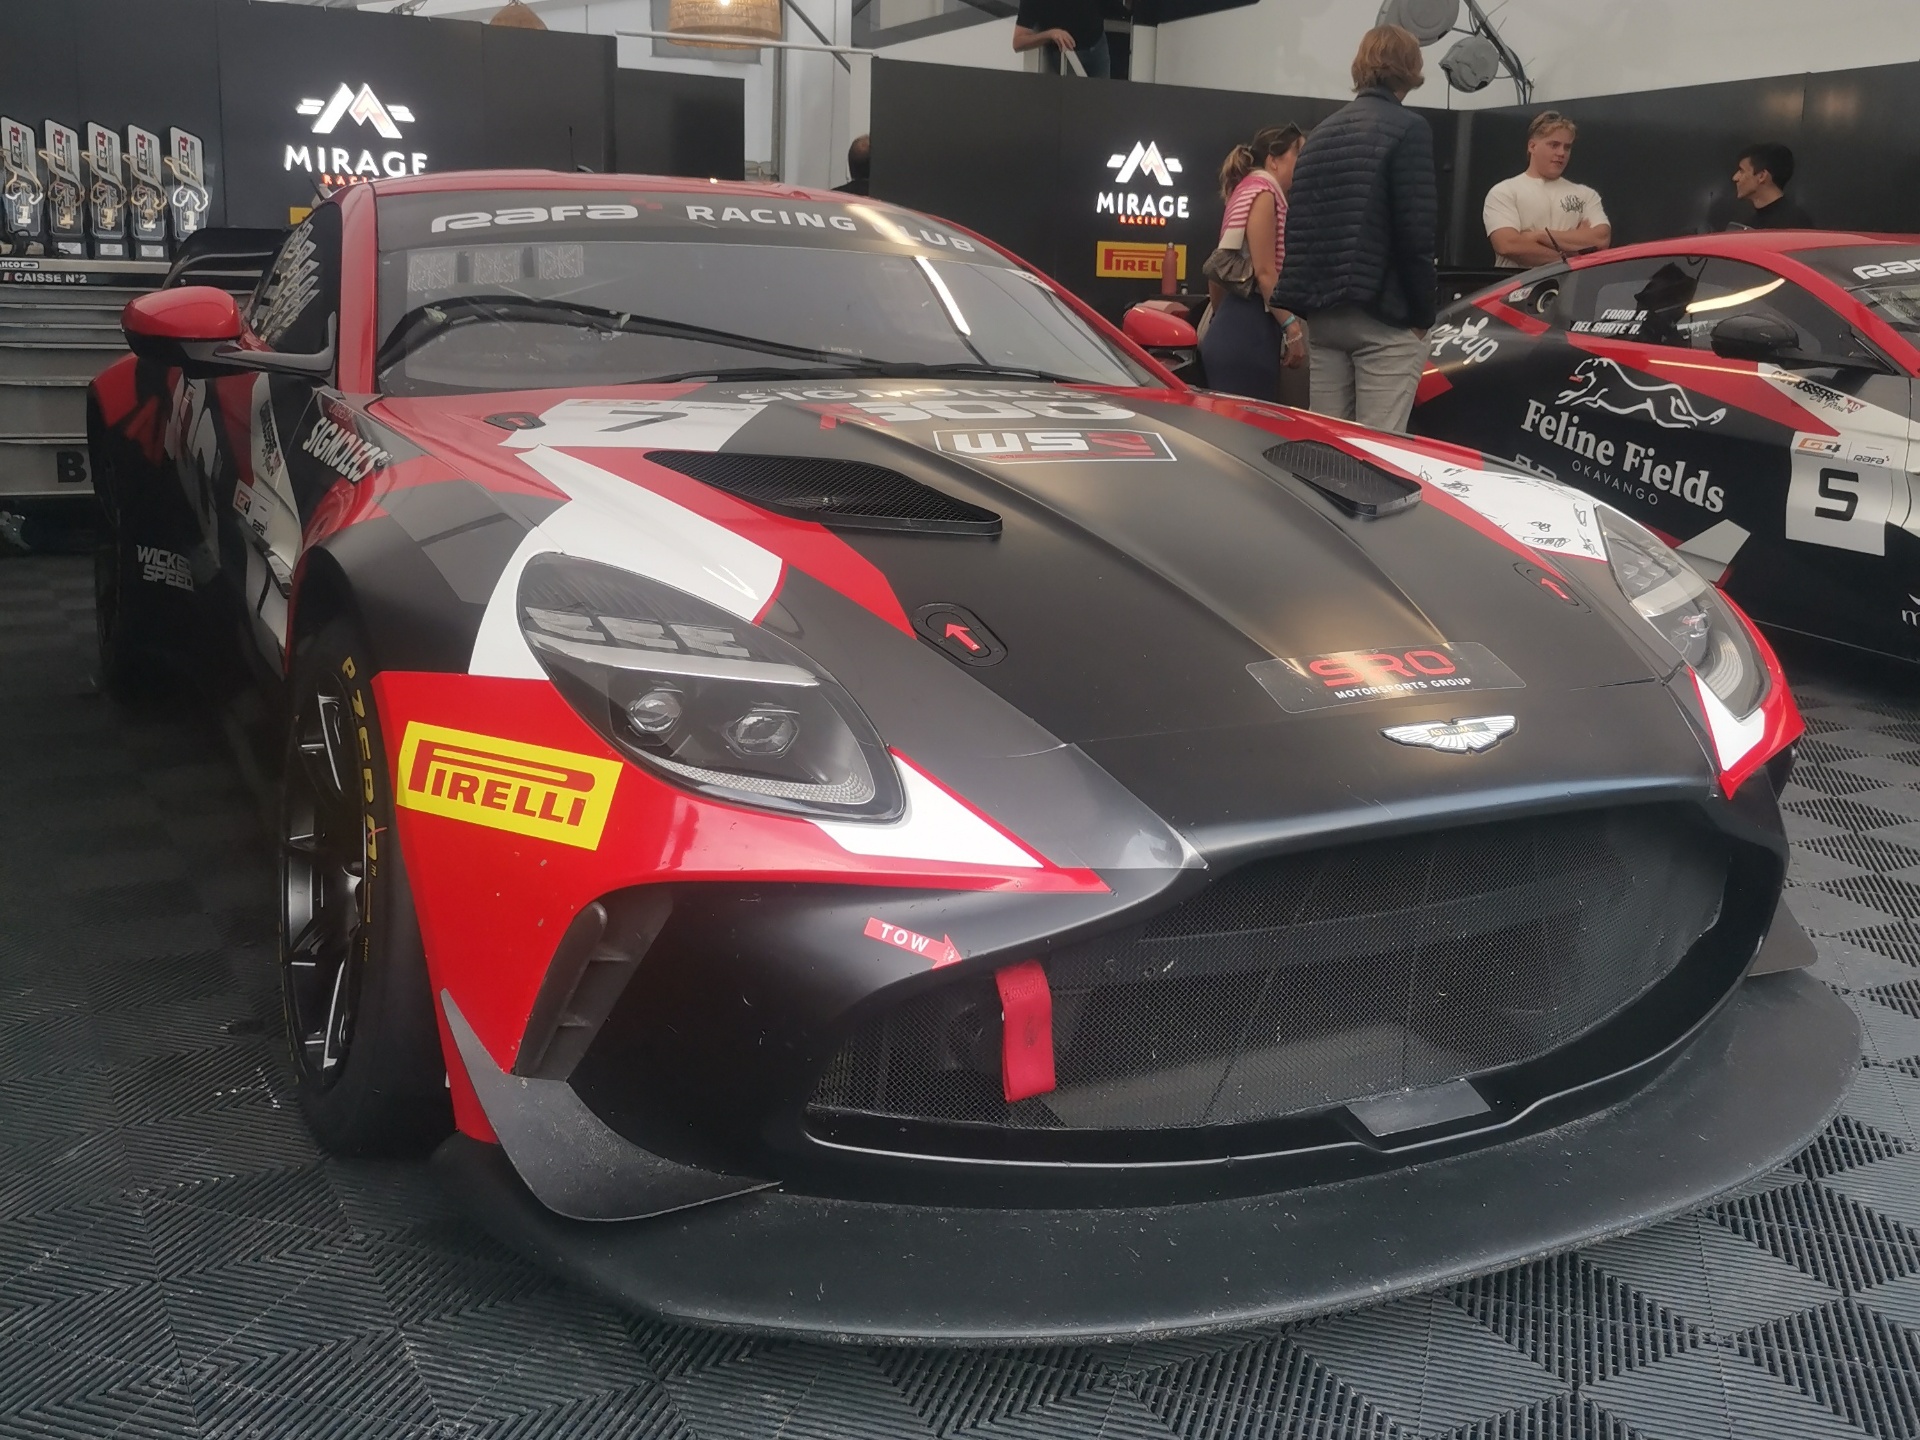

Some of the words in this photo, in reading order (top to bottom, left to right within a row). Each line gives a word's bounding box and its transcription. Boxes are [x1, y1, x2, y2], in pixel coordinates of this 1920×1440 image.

[284, 144, 428, 177] MIRAGE
[686, 205, 857, 232] RACING
[1096, 192, 1190, 218] MIRAGE
[1104, 249, 1179, 273] PIREL
[14, 272, 62, 283] CAISSE
[1570, 321, 1592, 332] DEL
[1590, 321, 1631, 334] SARTE
[1601, 308, 1637, 321] FARIA
[595, 409, 689, 433] 7
[56, 451, 87, 483] B
[1520, 399, 1615, 467] Feline
[1622, 441, 1725, 514] Fields
[1572, 459, 1658, 505] OKAVANGO
[1814, 467, 1860, 521] 5
[136, 544, 191, 575] WICKED
[142, 563, 195, 593] SPEED
[1308, 650, 1456, 687] SRO
[1334, 680, 1428, 700] MOTORSPORTS
[1430, 677, 1472, 688] GROUP
[408, 738, 596, 828] PIRELLI
[881, 923, 930, 953] TOW
